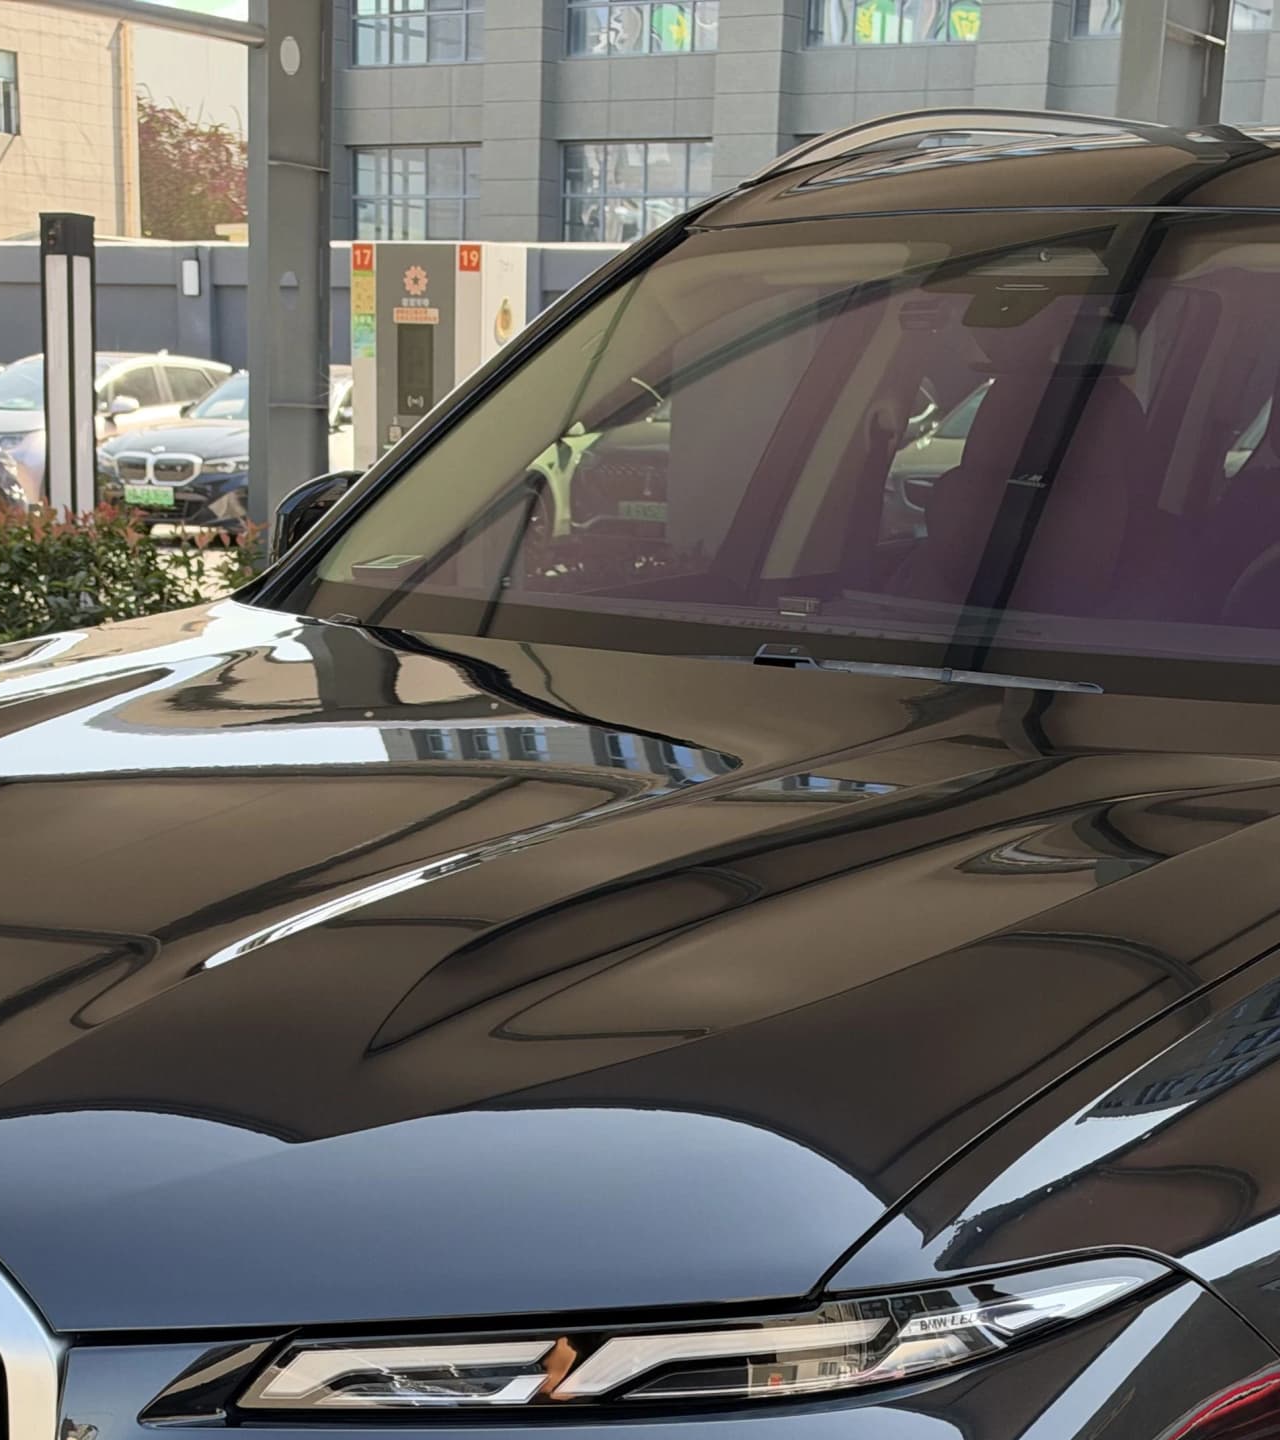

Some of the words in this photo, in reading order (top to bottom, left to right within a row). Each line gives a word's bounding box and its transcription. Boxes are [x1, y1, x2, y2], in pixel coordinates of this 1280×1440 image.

[355, 249, 371, 265] 17
[461, 250, 479, 266] 19
[919, 1317, 947, 1331] BMW
